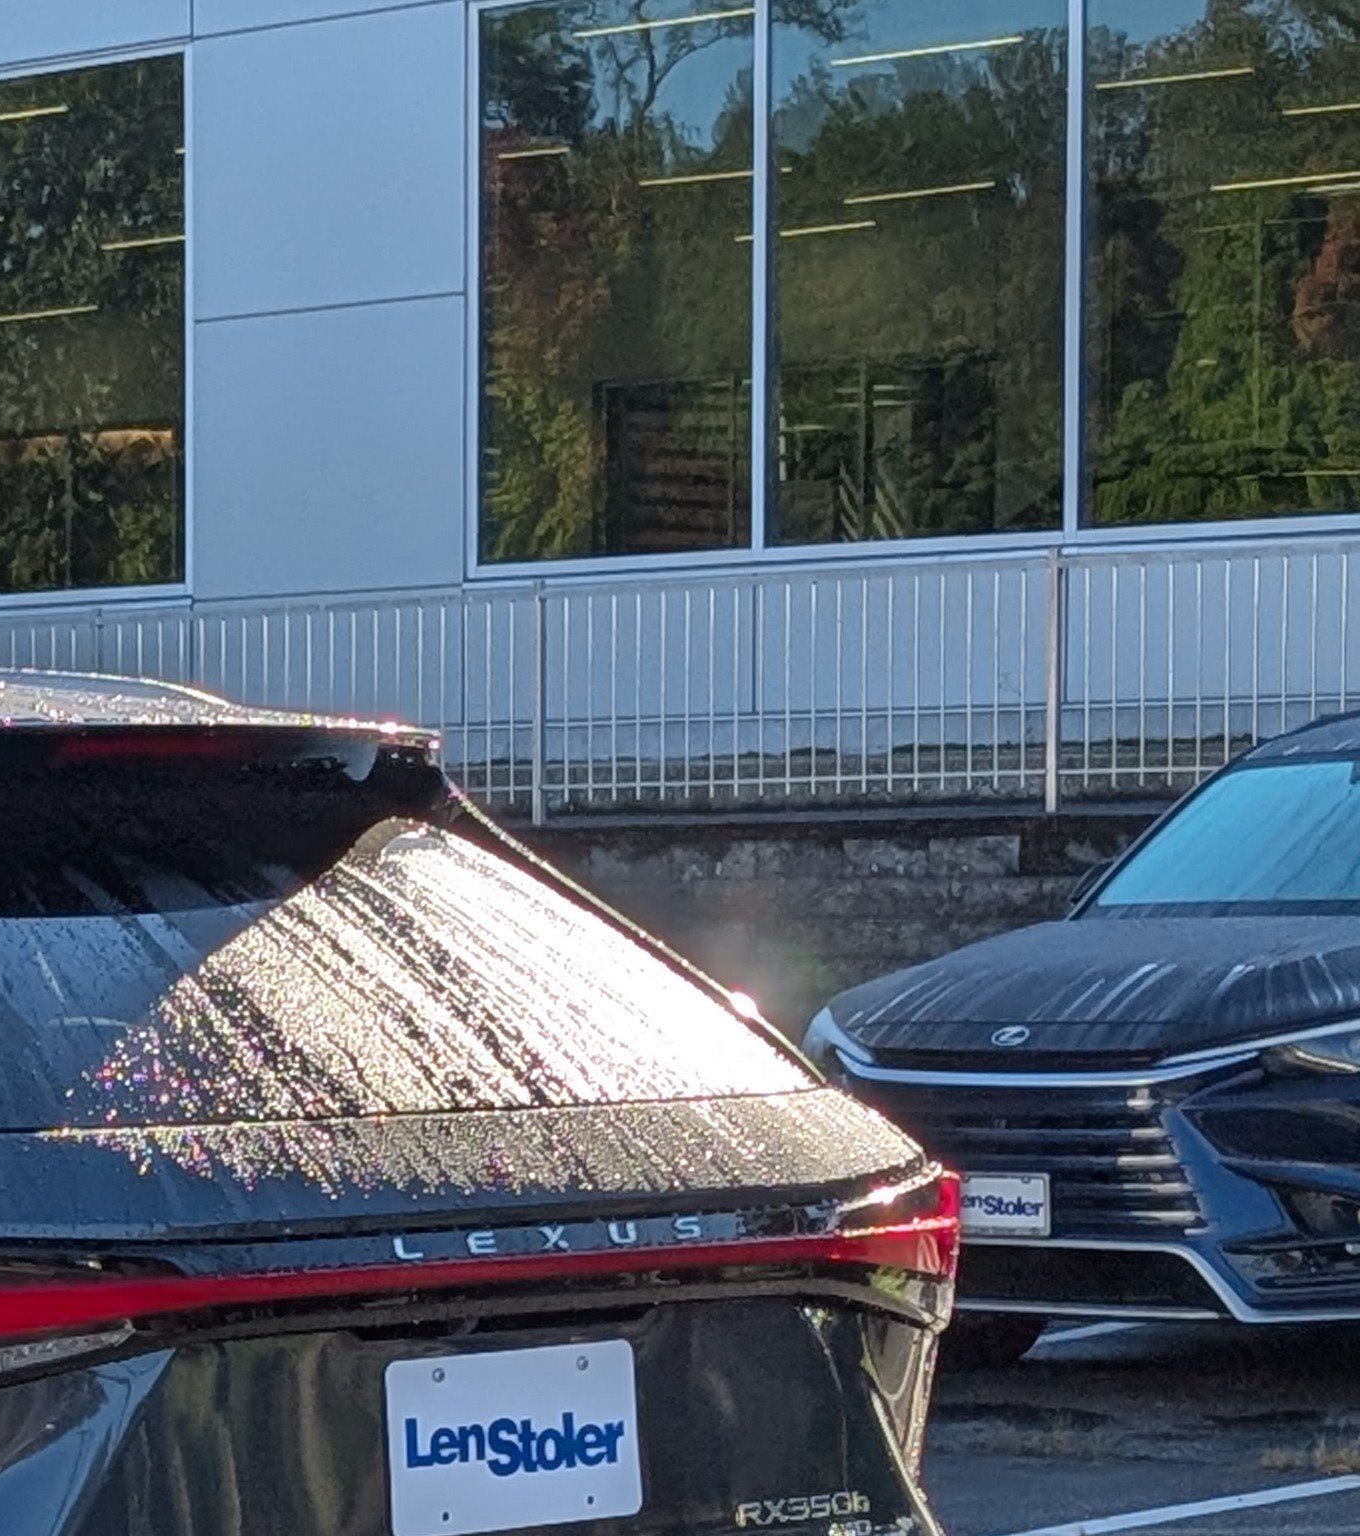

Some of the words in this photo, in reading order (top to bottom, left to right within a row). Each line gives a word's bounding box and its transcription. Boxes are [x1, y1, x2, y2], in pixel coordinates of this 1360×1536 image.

[960, 1195, 1043, 1216] enStoler
[393, 1216, 701, 1260] LEXUS
[405, 1412, 624, 1477] LenStoler
[735, 1491, 870, 1527] RX350h
